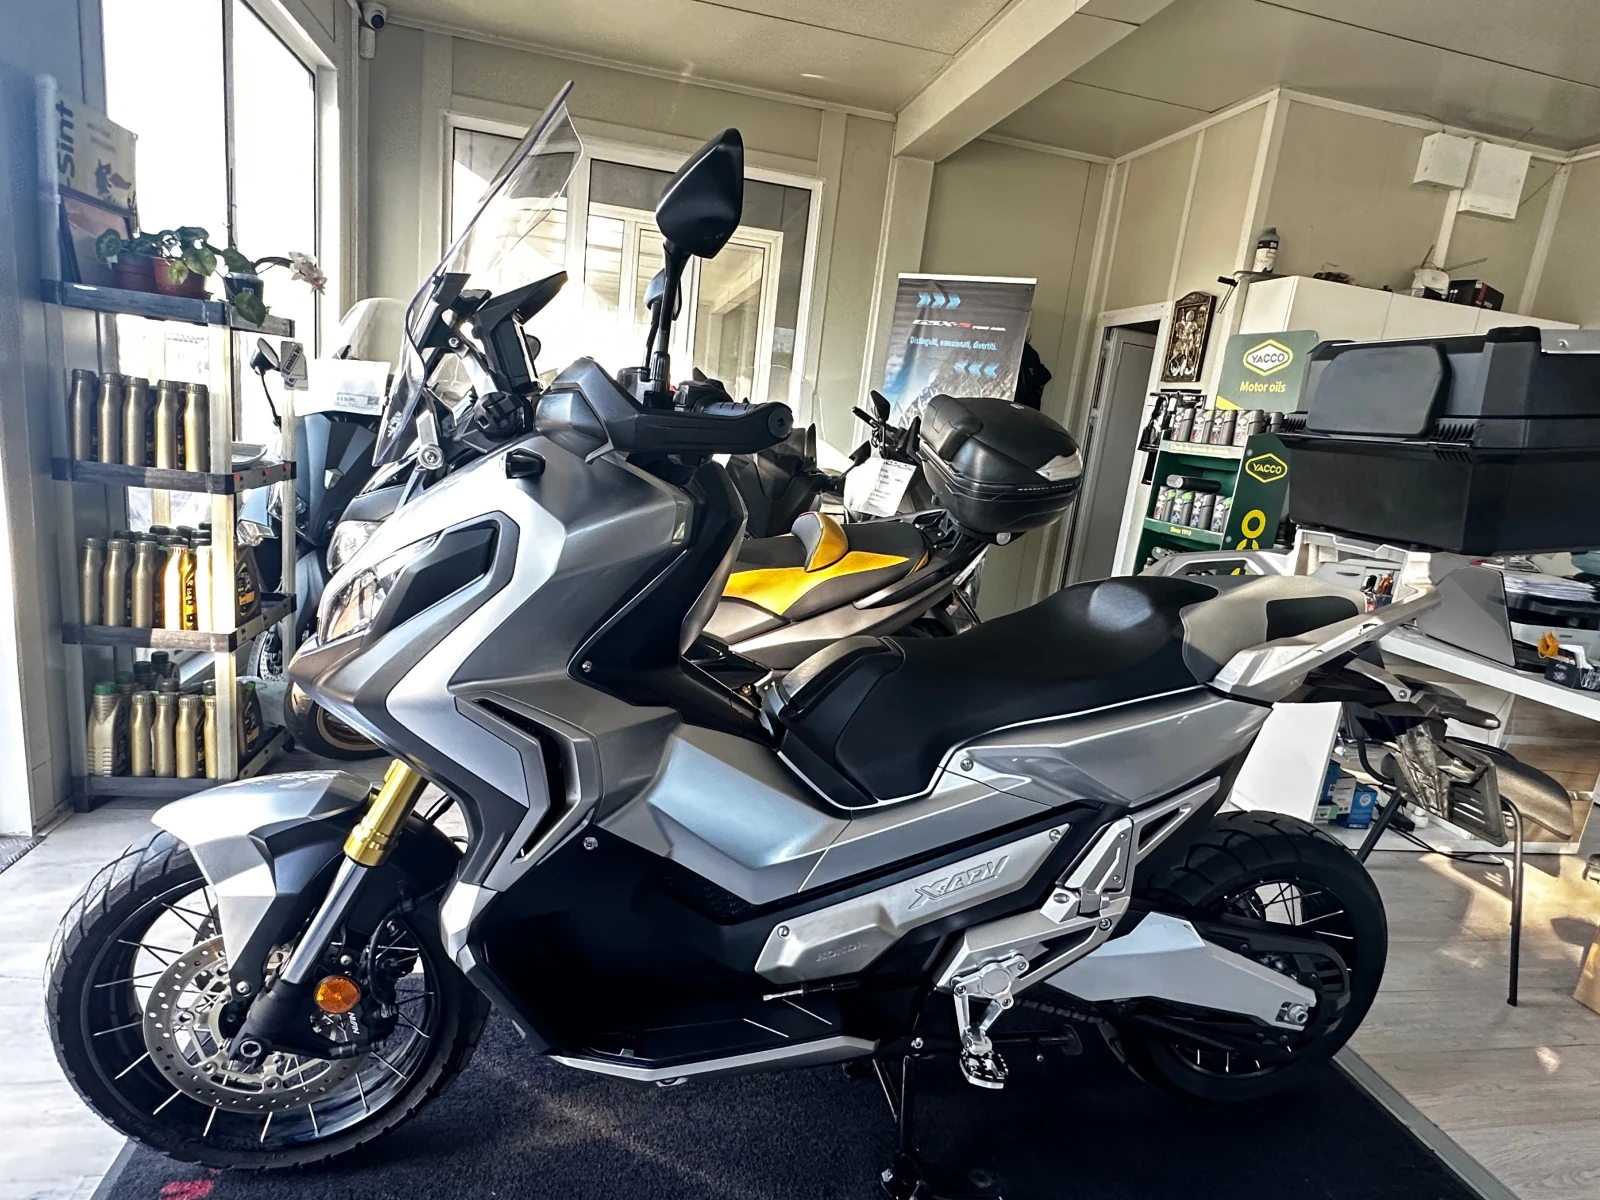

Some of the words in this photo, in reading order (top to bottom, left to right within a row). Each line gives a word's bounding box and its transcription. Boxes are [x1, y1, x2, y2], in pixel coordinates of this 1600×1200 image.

[1251, 353, 1285, 364] YACCO
[1240, 381, 1269, 392] Motor
[1269, 381, 1287, 393] oils
[1252, 463, 1282, 475] YACCO
[815, 942, 868, 962] HONDA
